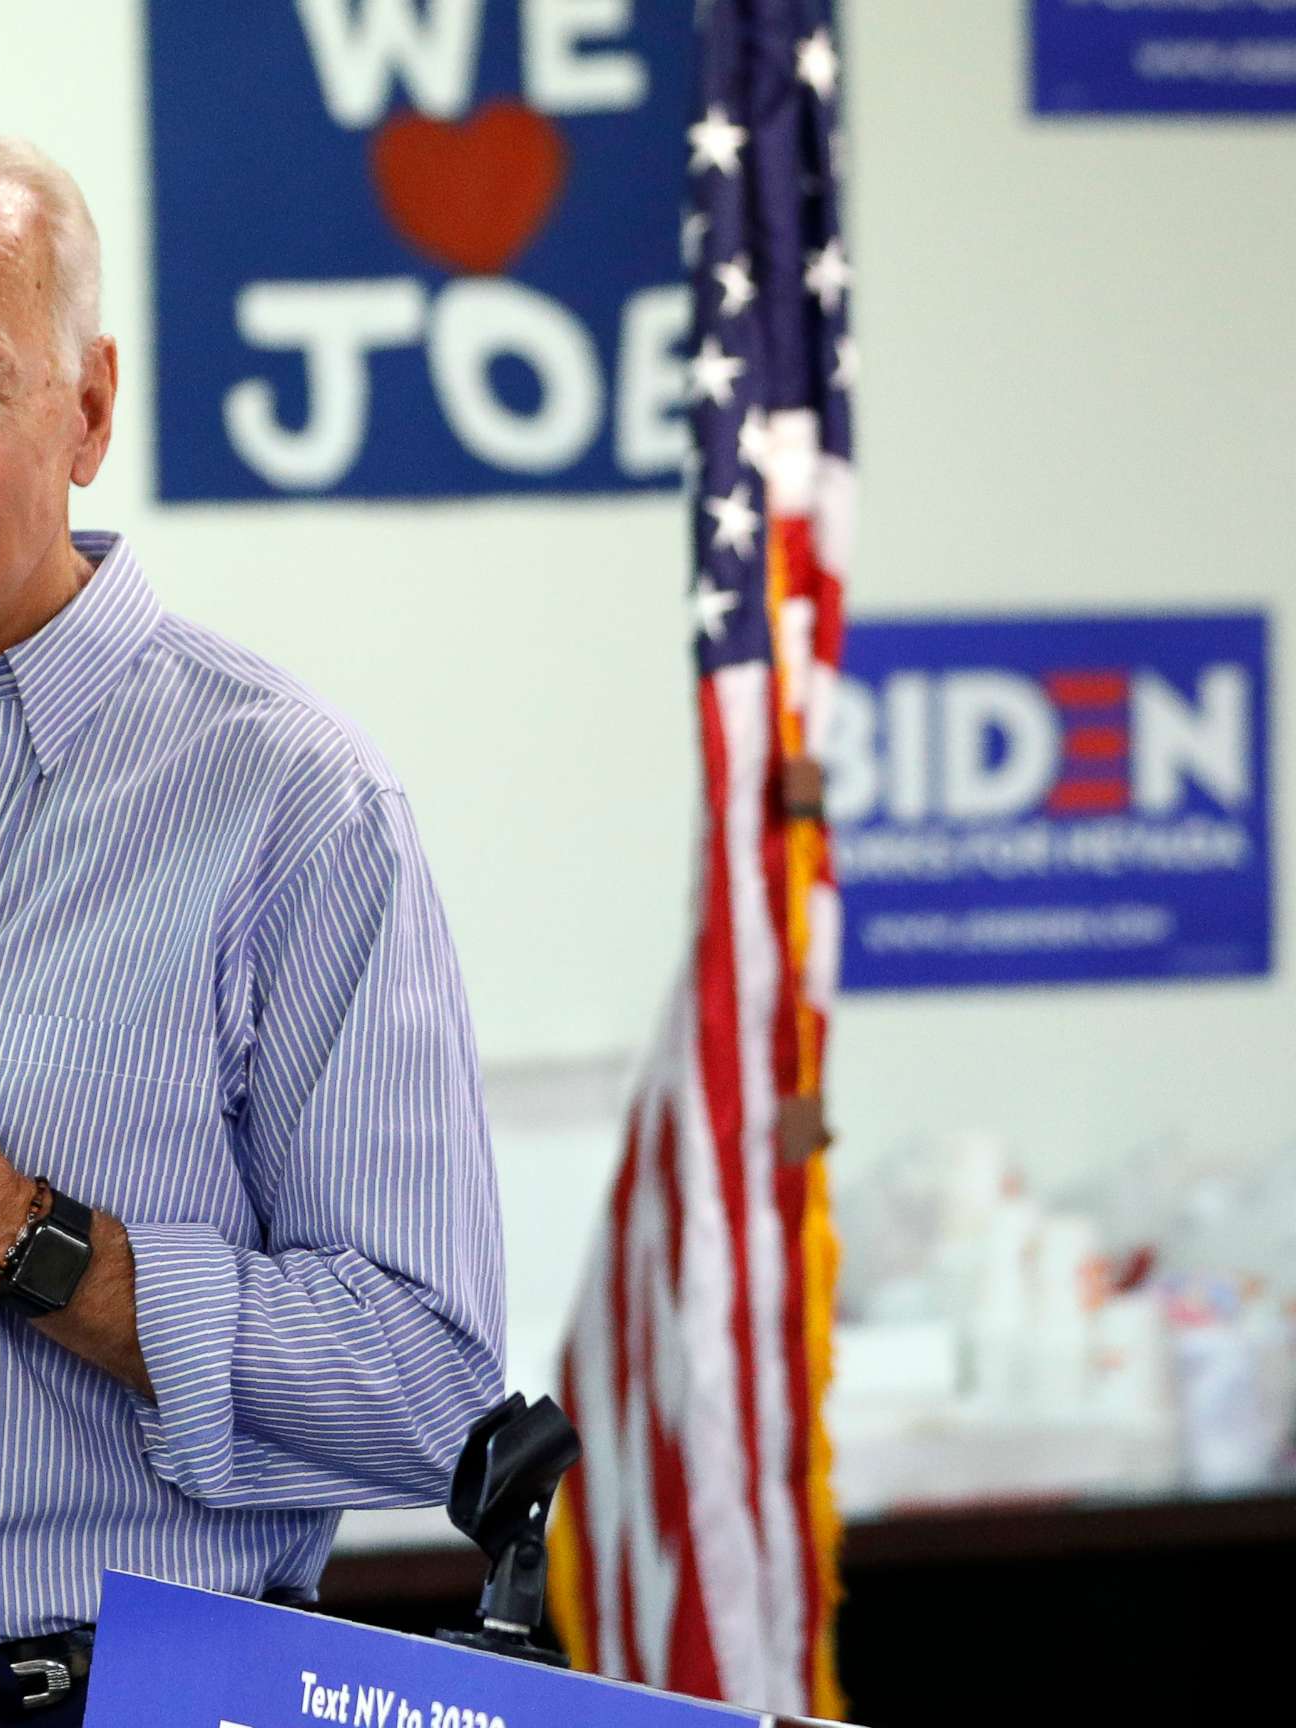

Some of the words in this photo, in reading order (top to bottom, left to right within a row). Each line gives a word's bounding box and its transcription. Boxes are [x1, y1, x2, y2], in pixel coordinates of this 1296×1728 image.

[294, 0, 647, 128] WE
[301, 1670, 350, 1724] Text
[354, 1684, 395, 1728] NV
[398, 1698, 423, 1728] to
